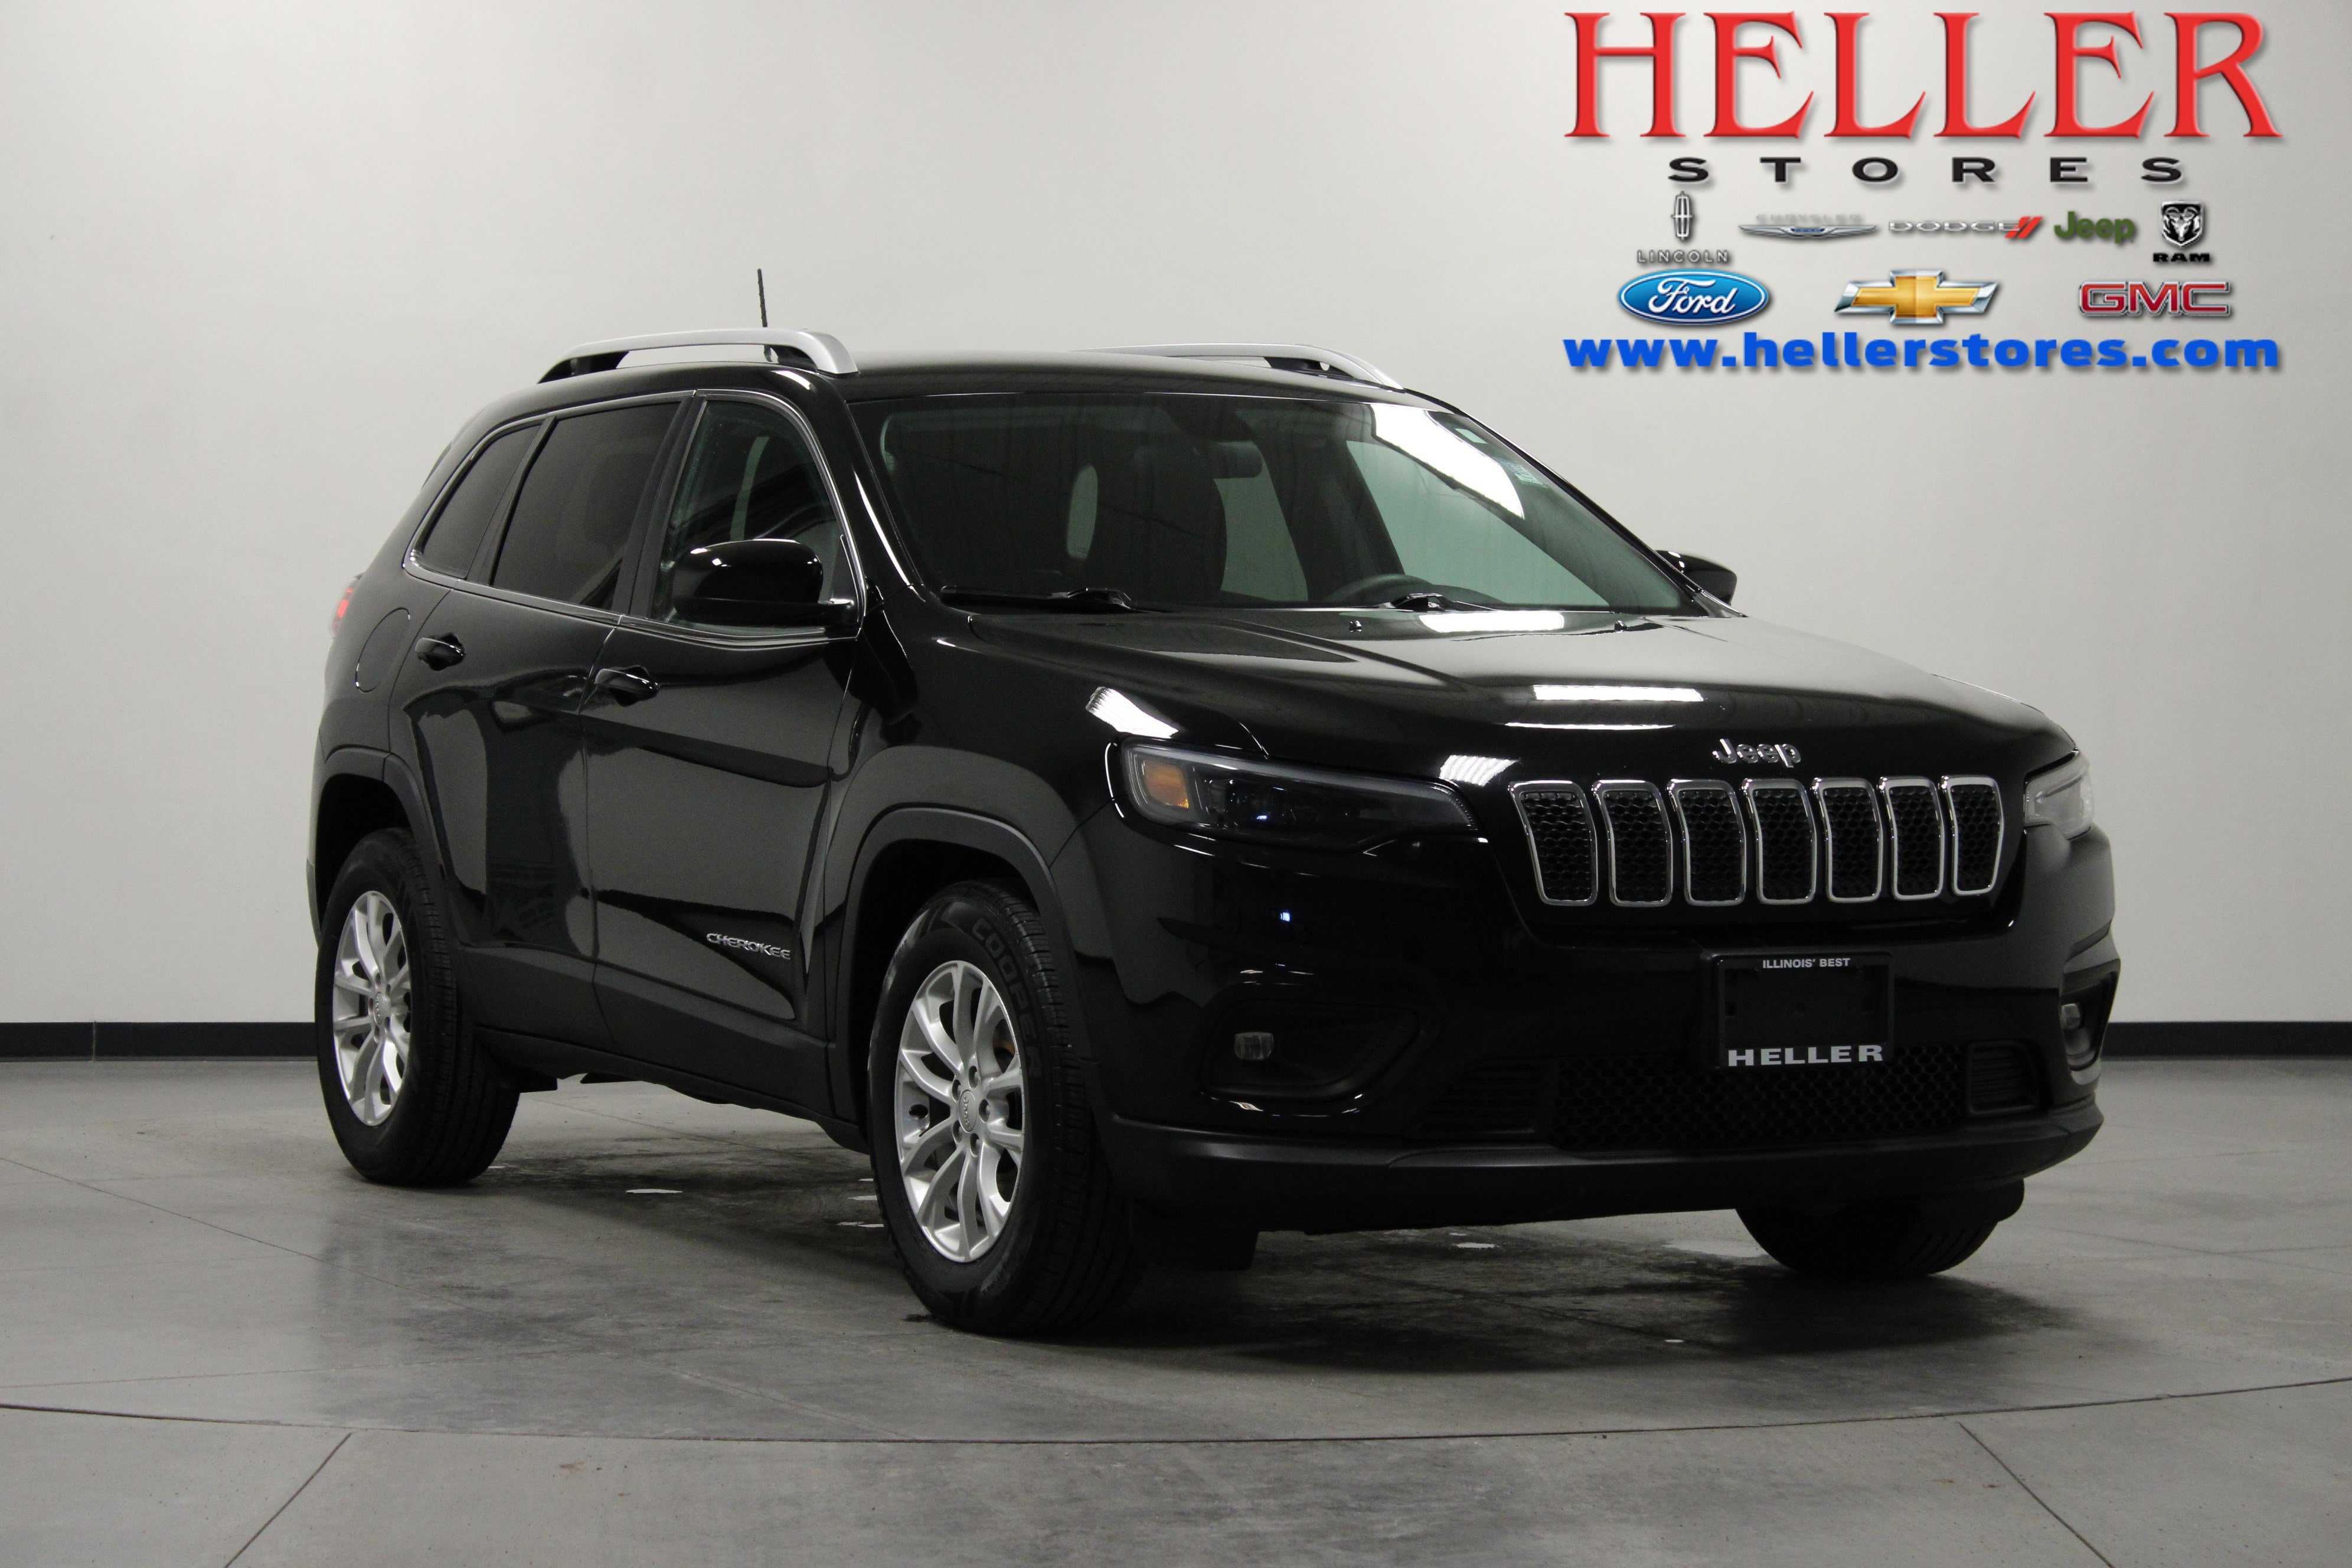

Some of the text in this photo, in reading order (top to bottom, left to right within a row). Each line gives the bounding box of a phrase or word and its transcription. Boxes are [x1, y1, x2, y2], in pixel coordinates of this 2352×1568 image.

[1712, 738, 1801, 768] Jeep
[706, 933, 791, 961] CHEROKEE
[1762, 958, 1851, 969] ILLINOIS' BEST
[972, 917, 1043, 1079] COOPER
[1727, 1044, 1883, 1067] HELLER
